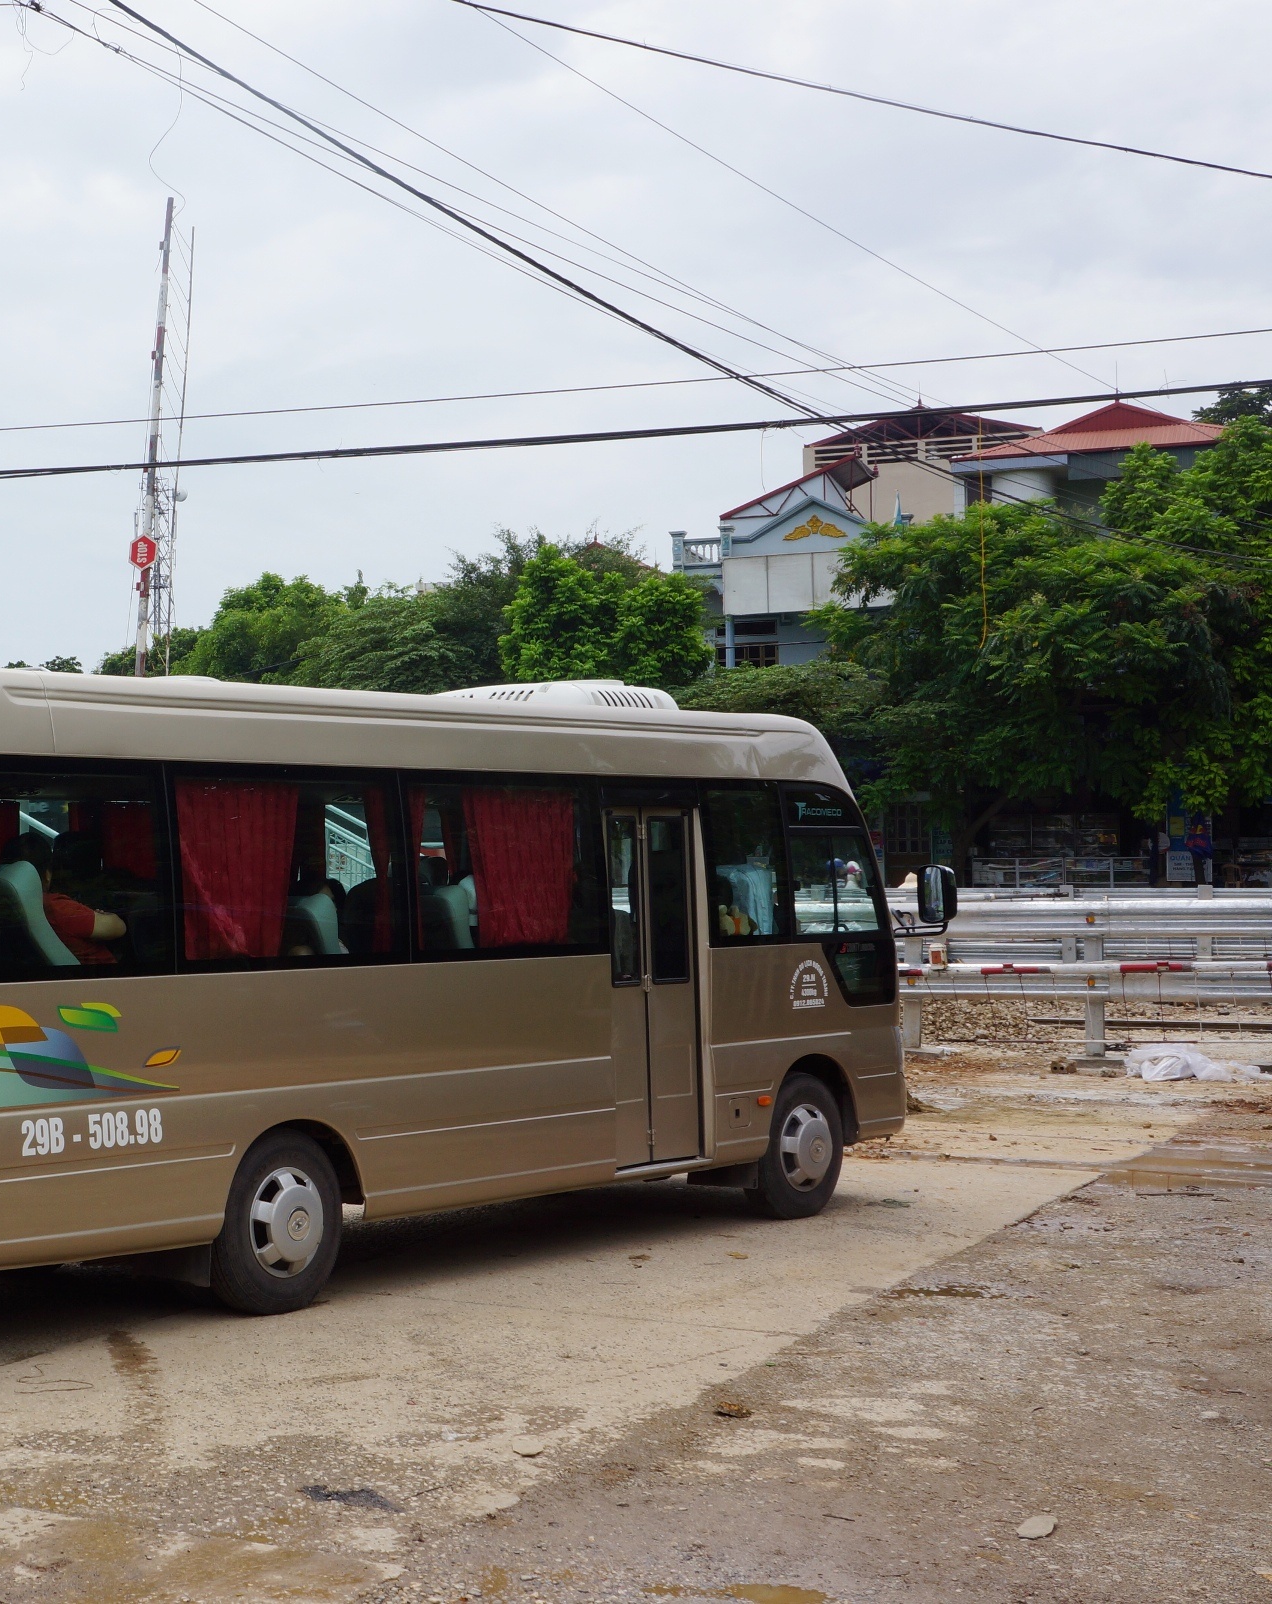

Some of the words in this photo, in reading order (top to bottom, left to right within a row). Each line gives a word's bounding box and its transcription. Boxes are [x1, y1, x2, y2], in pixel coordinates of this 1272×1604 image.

[136, 541, 149, 564] STOP
[794, 801, 842, 821] TRACOMECO
[21, 1117, 65, 1157] 29B
[88, 1108, 163, 1150] 508.98
